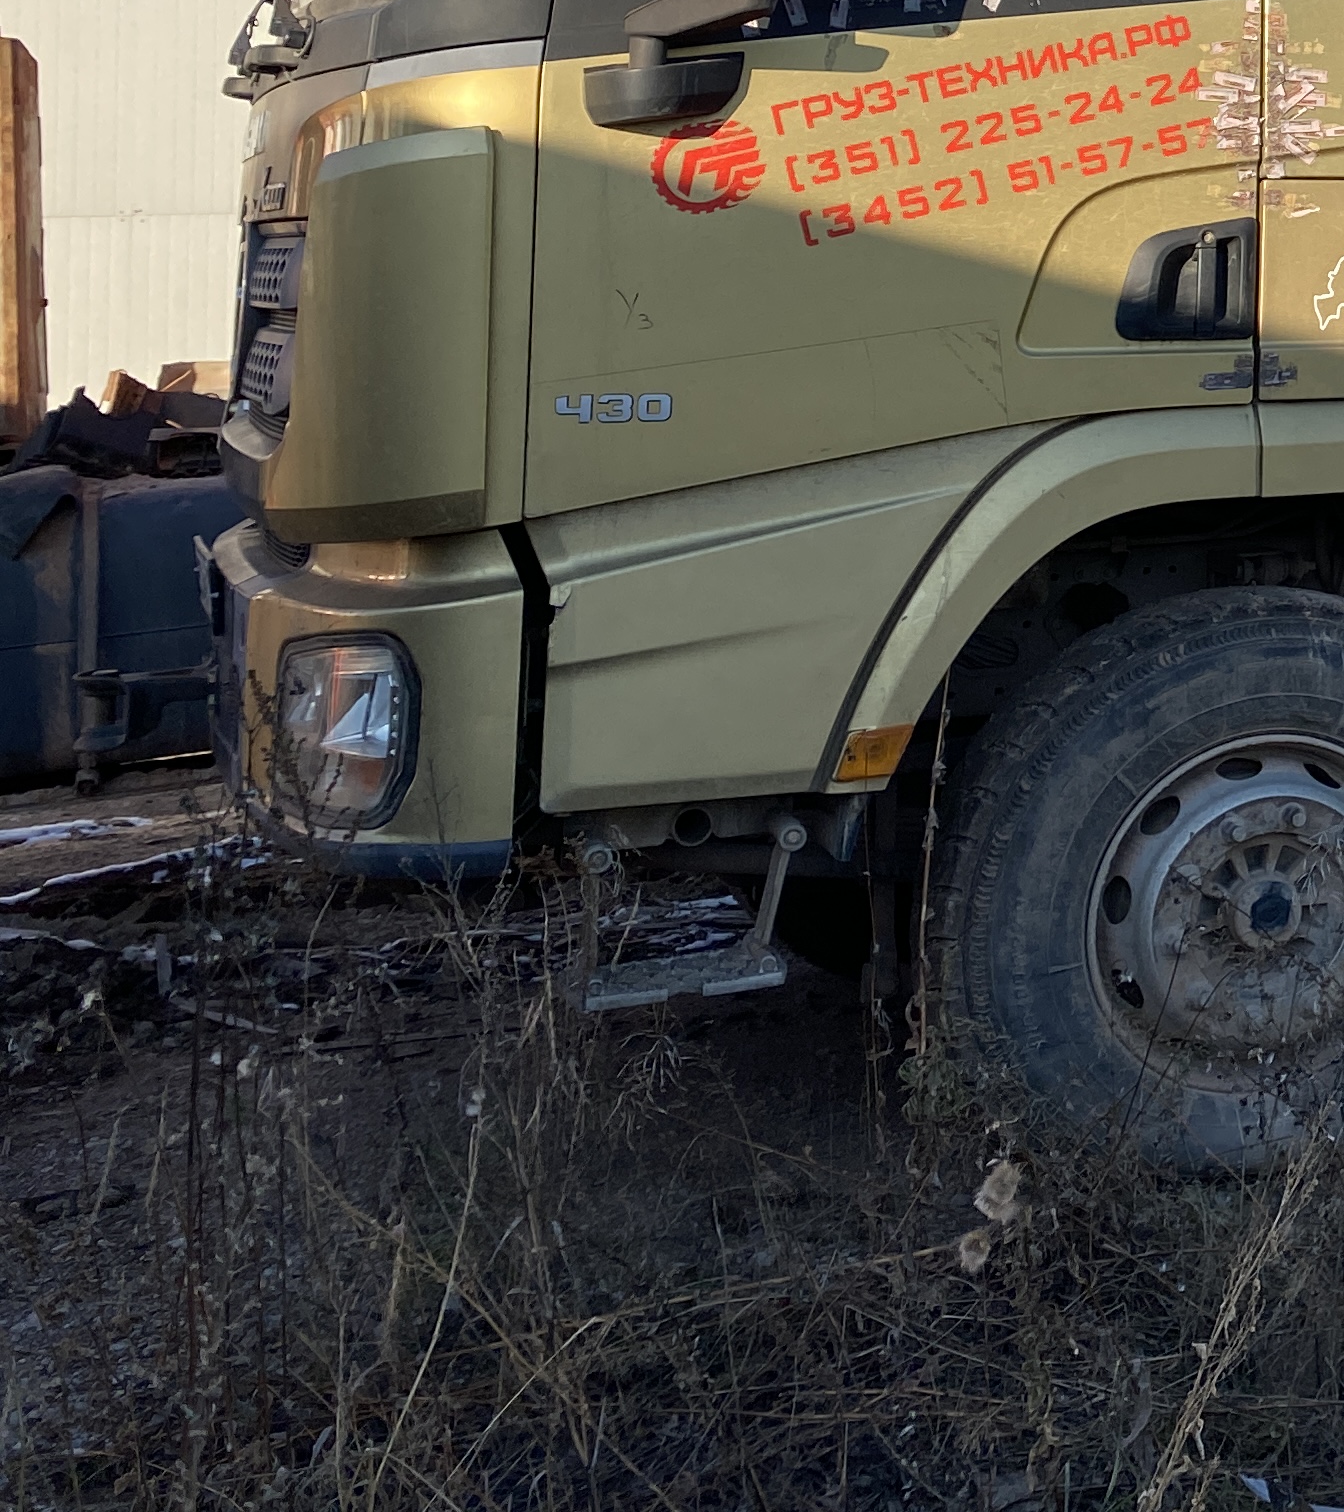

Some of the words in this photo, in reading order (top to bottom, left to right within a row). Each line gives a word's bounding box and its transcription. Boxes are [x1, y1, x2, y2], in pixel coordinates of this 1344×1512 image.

[769, 13, 1193, 137] ГРУЗ-ТЕХНИКА.РФ
[940, 65, 1205, 154] 225-24-24
[553, 391, 674, 425] 430
